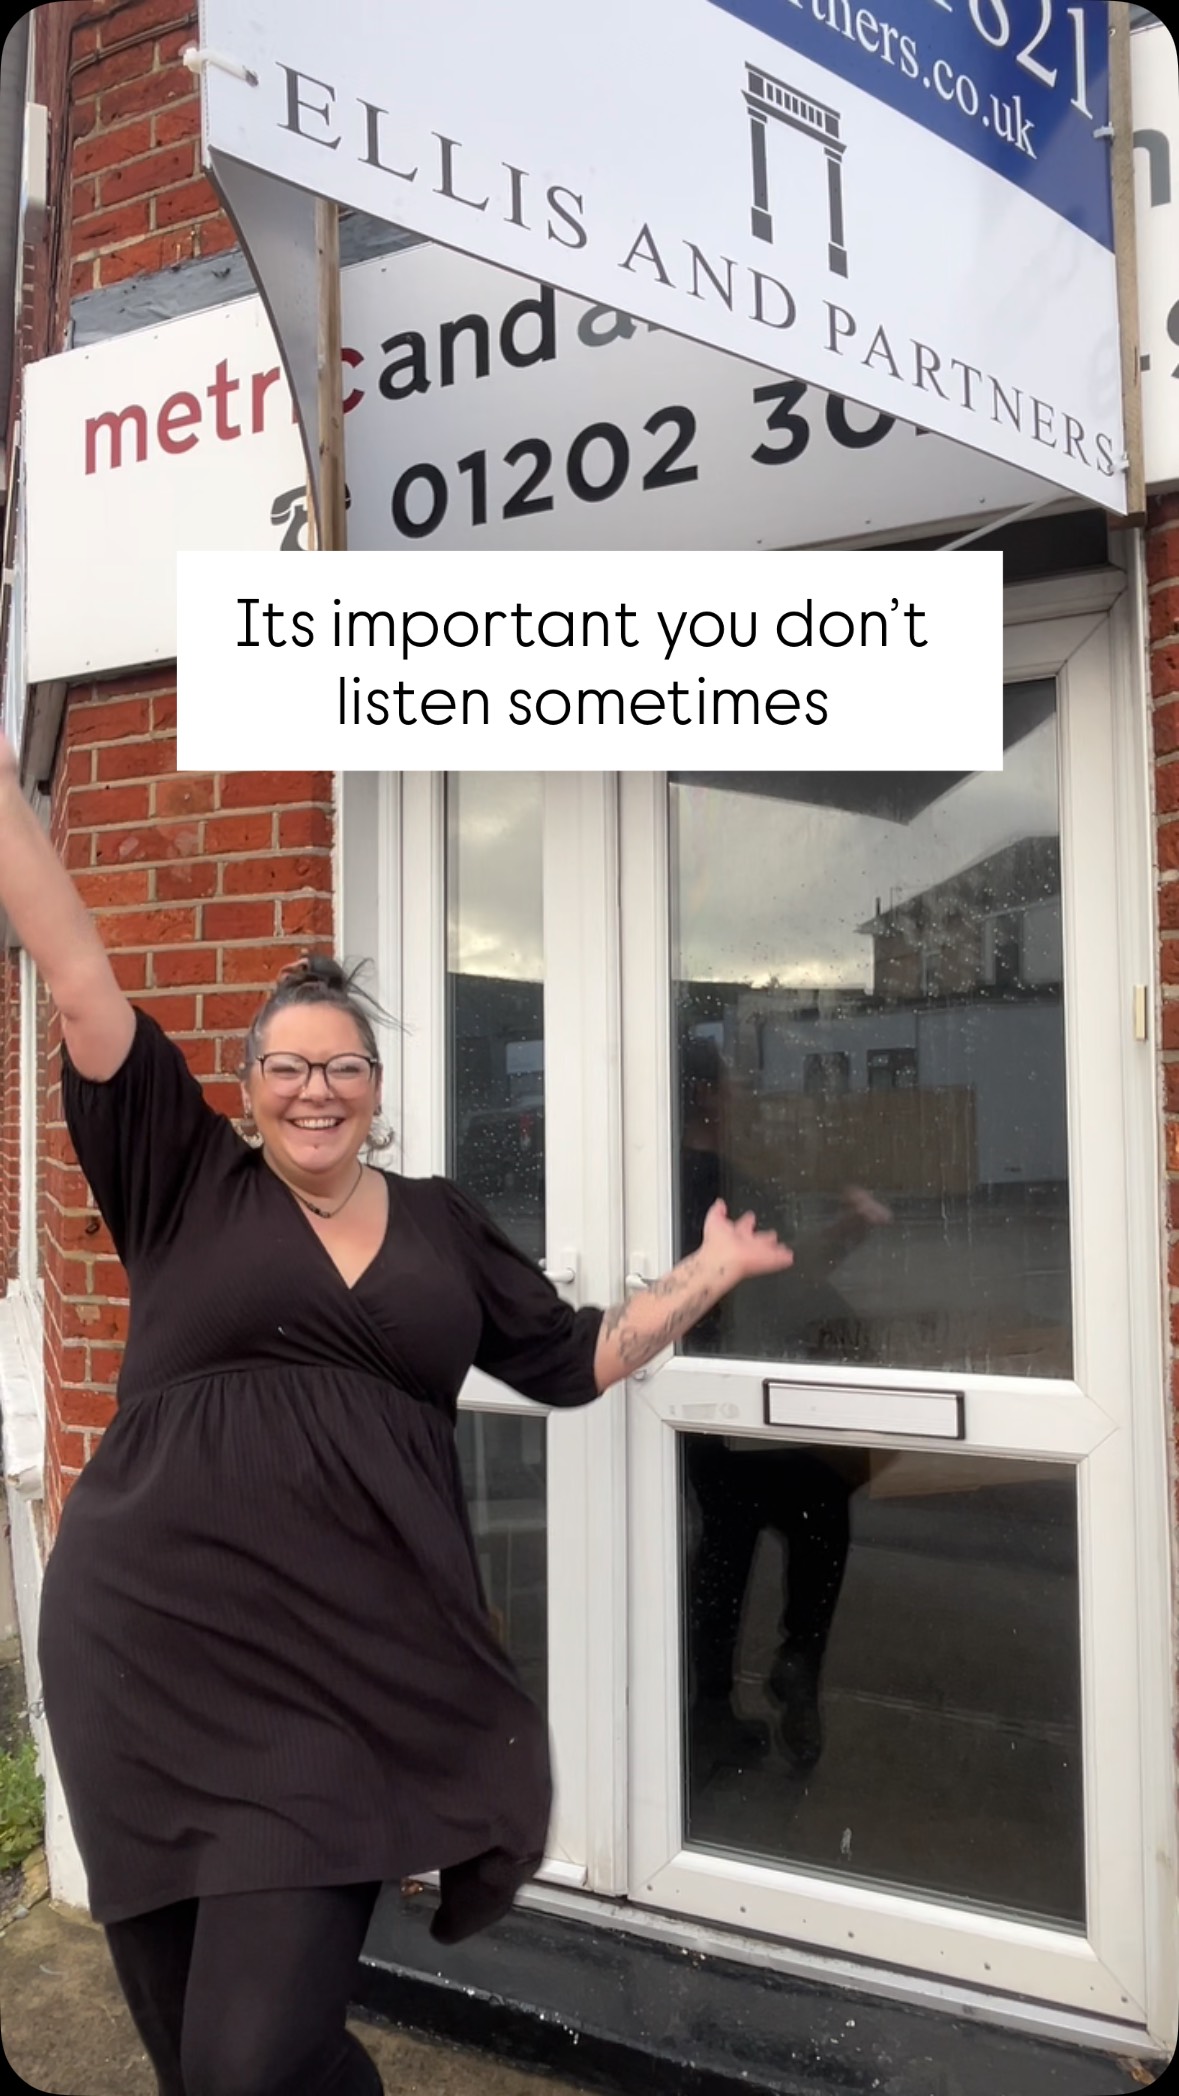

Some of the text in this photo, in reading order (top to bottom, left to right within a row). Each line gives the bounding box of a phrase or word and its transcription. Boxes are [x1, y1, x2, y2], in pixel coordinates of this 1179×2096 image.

[275, 61, 588, 250] ELLIS
[618, 222, 797, 331] AND
[823, 299, 1115, 478] PARTNERS
[84, 346, 365, 475] metrc
[391, 404, 699, 539] 01202
